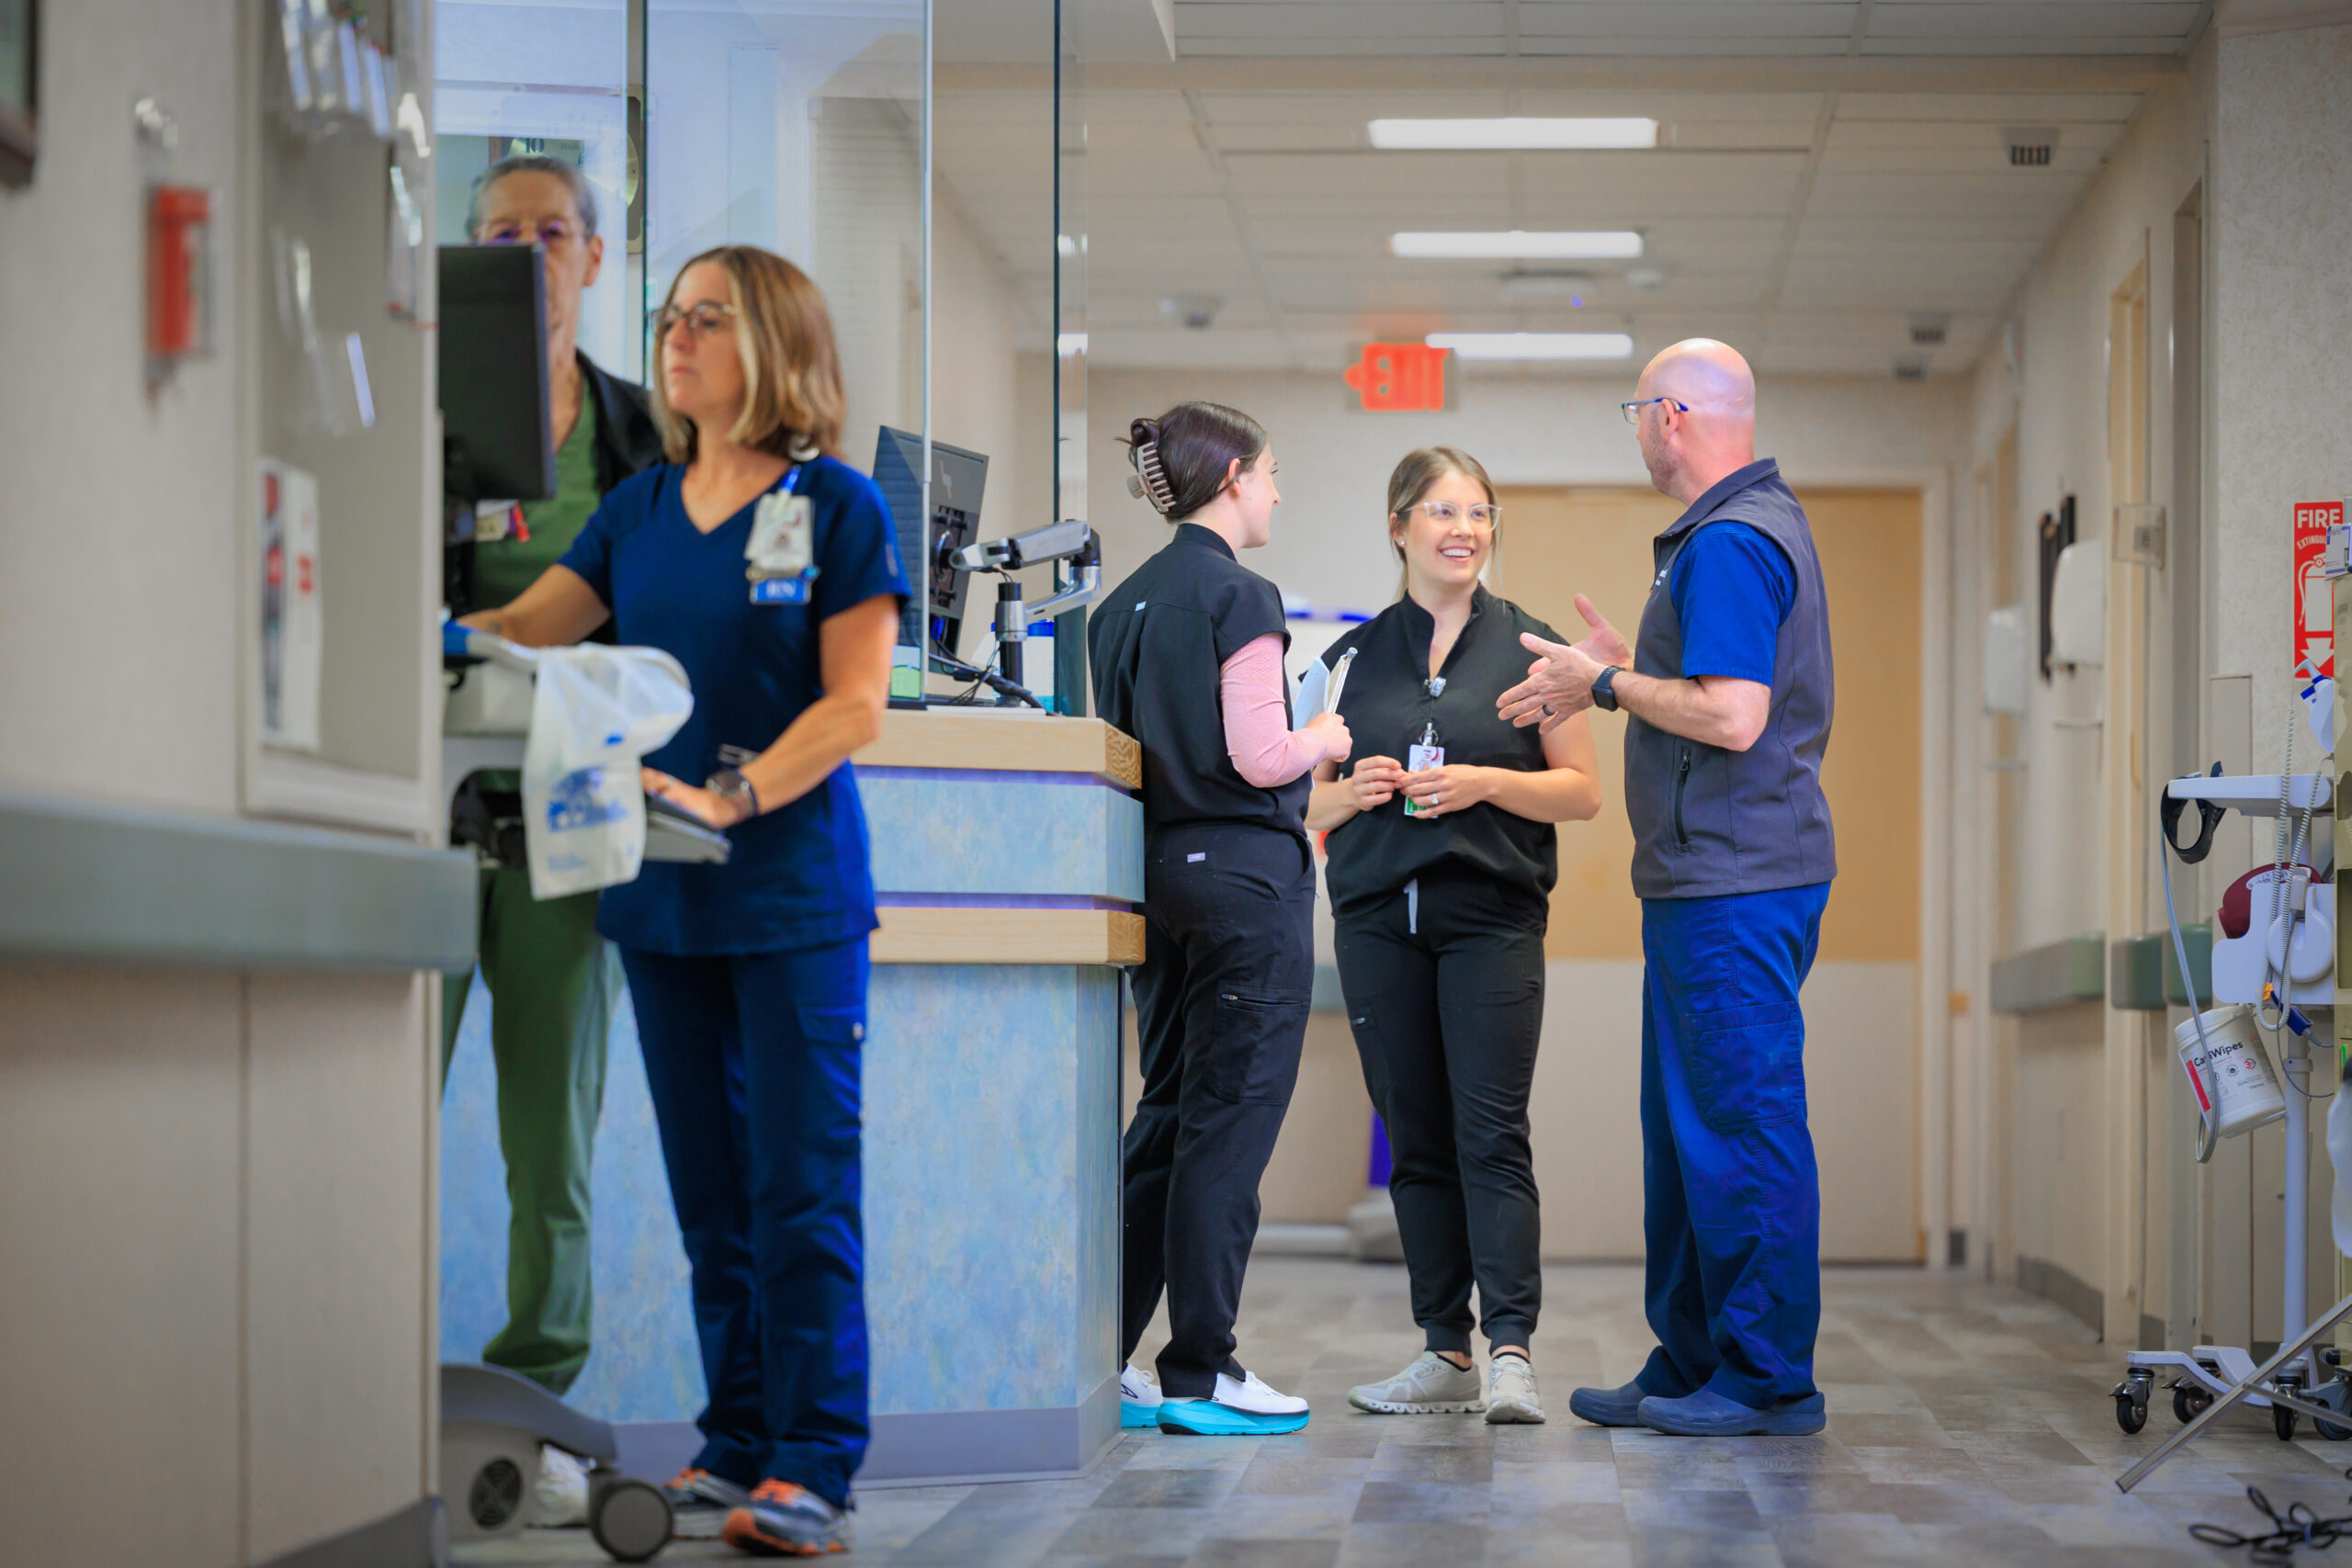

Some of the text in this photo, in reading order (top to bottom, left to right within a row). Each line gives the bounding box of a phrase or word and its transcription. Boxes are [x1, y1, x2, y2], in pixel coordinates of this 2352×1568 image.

[2297, 508, 2341, 528] FIRE
[2297, 535, 2326, 549] EXTINGUI
[2194, 1042, 2244, 1066] CaiWipes
